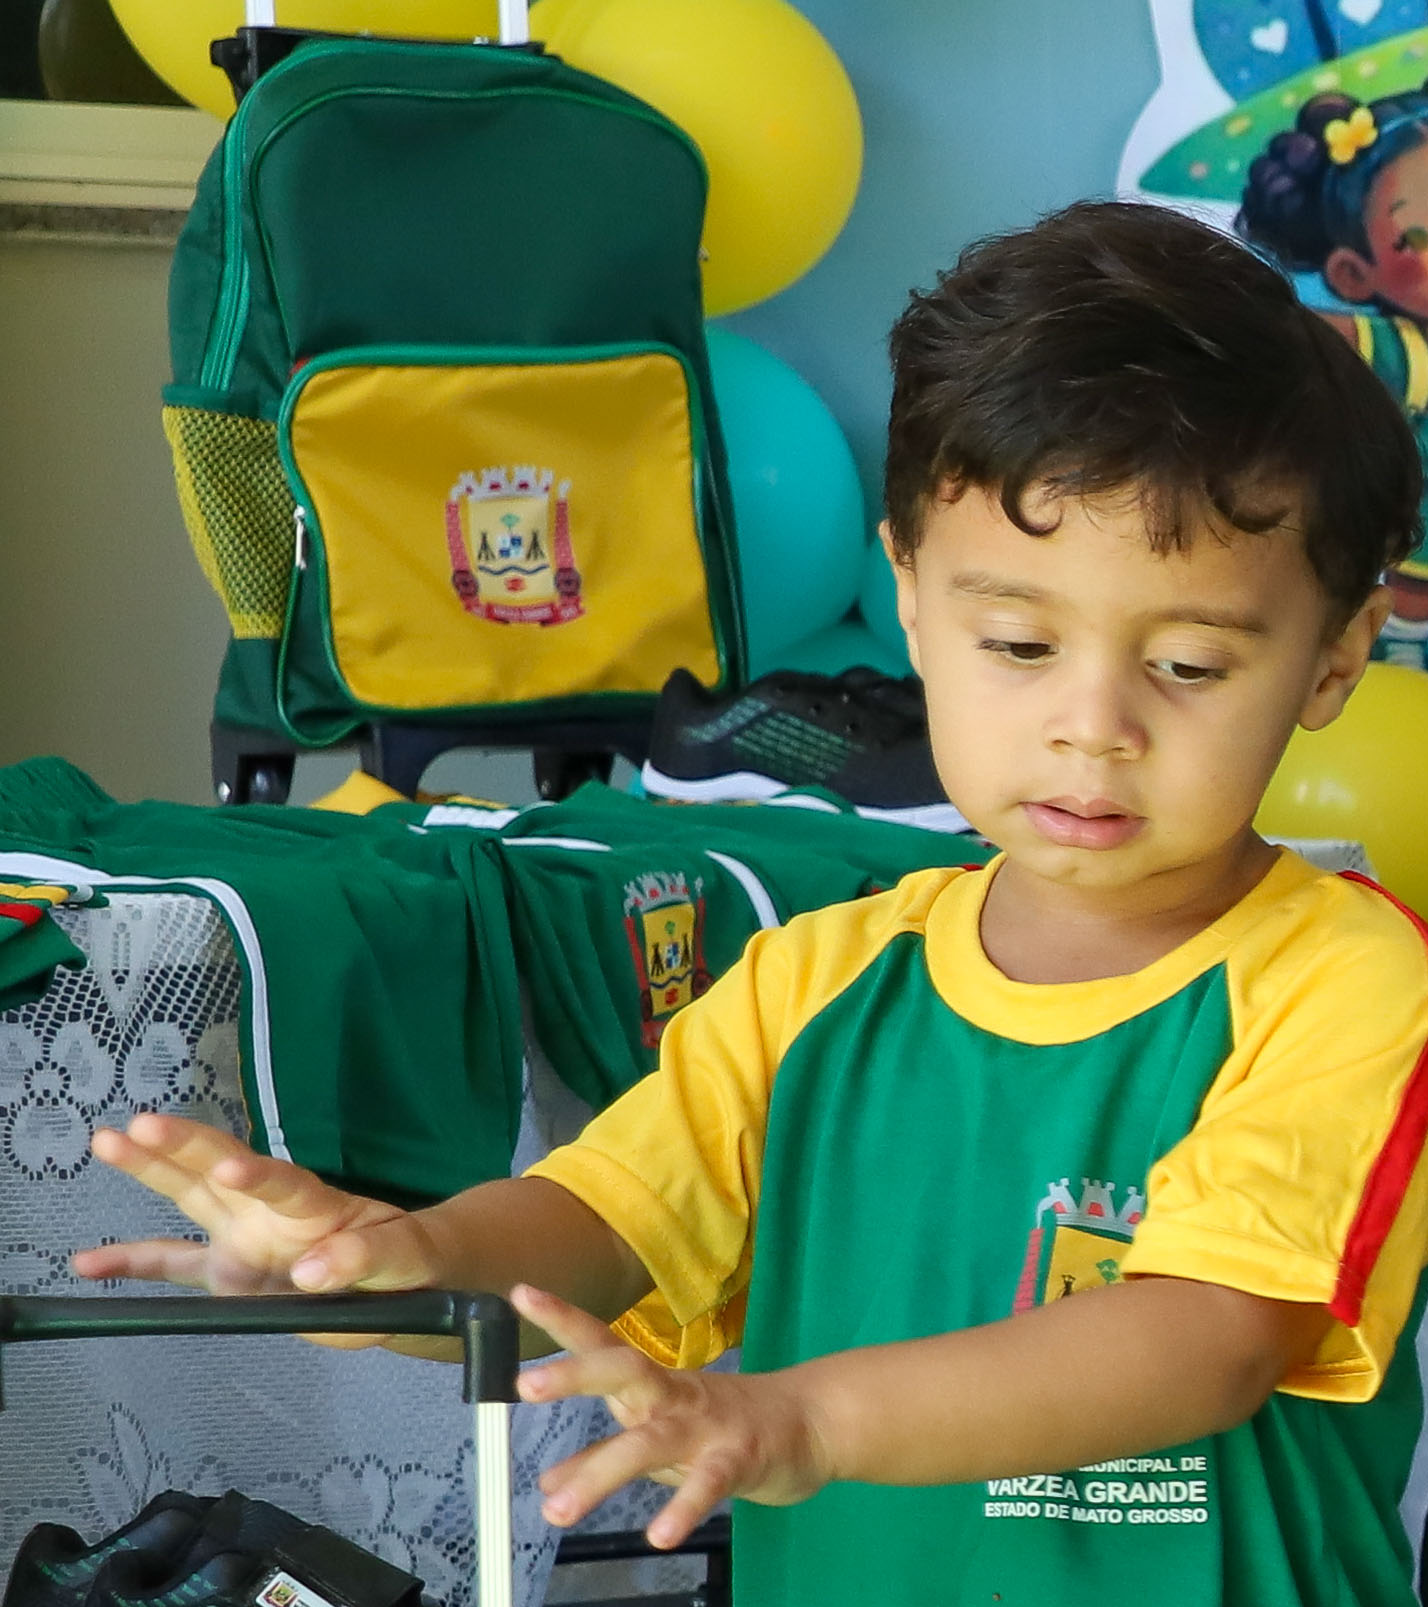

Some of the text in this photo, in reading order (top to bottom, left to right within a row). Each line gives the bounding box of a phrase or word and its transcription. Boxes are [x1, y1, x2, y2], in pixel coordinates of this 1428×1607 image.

[1180, 1456, 1207, 1472] DE
[1085, 1480, 1208, 1504] GRANDE
[984, 1502, 1208, 1524] ESTADO DE MATO GROSSO
